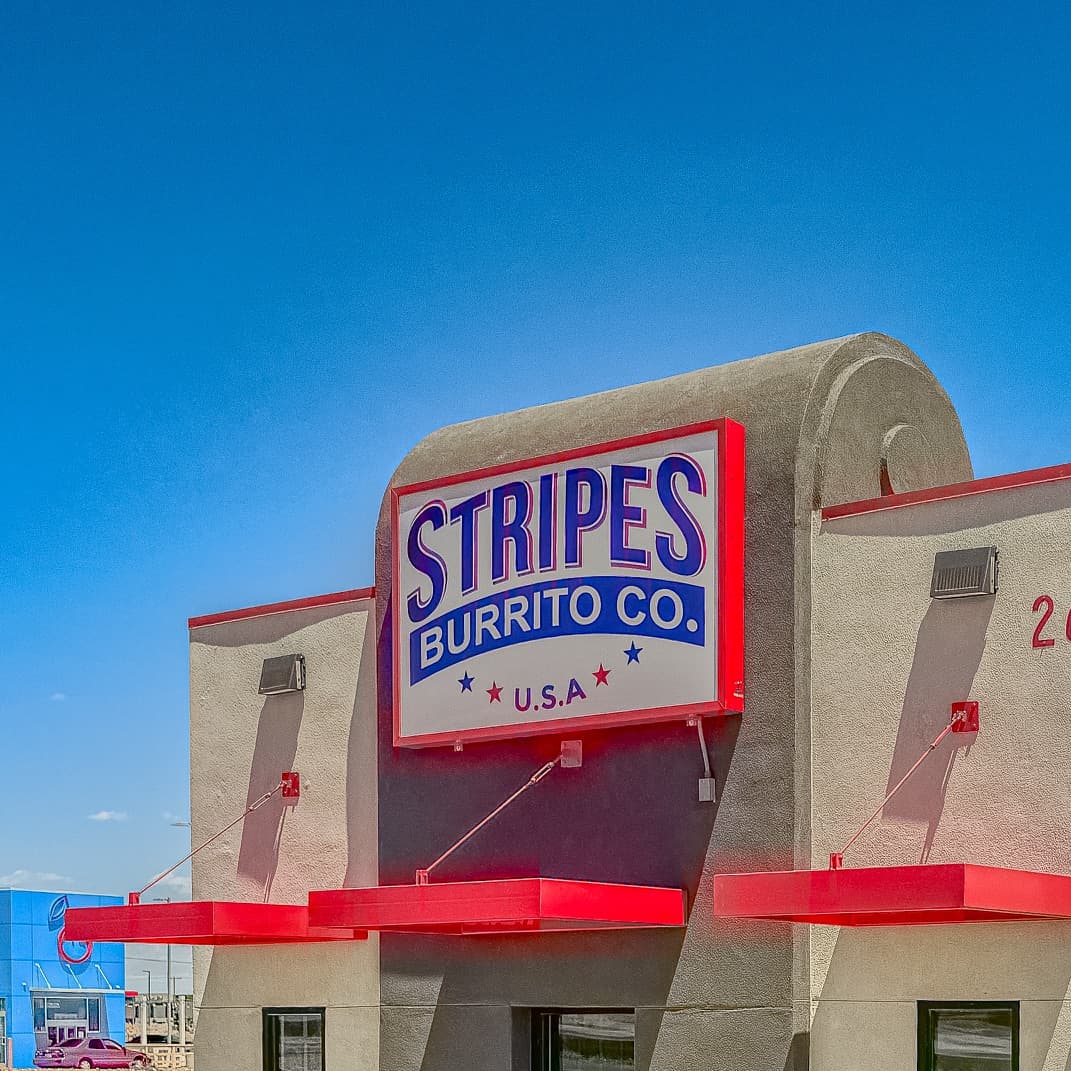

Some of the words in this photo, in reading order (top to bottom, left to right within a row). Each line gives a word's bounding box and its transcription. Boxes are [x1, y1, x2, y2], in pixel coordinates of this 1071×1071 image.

[407, 452, 707, 623] STRIPES
[420, 585, 602, 669] BURRITO
[616, 586, 698, 632] CO.
[514, 678, 587, 712] U.S.A
